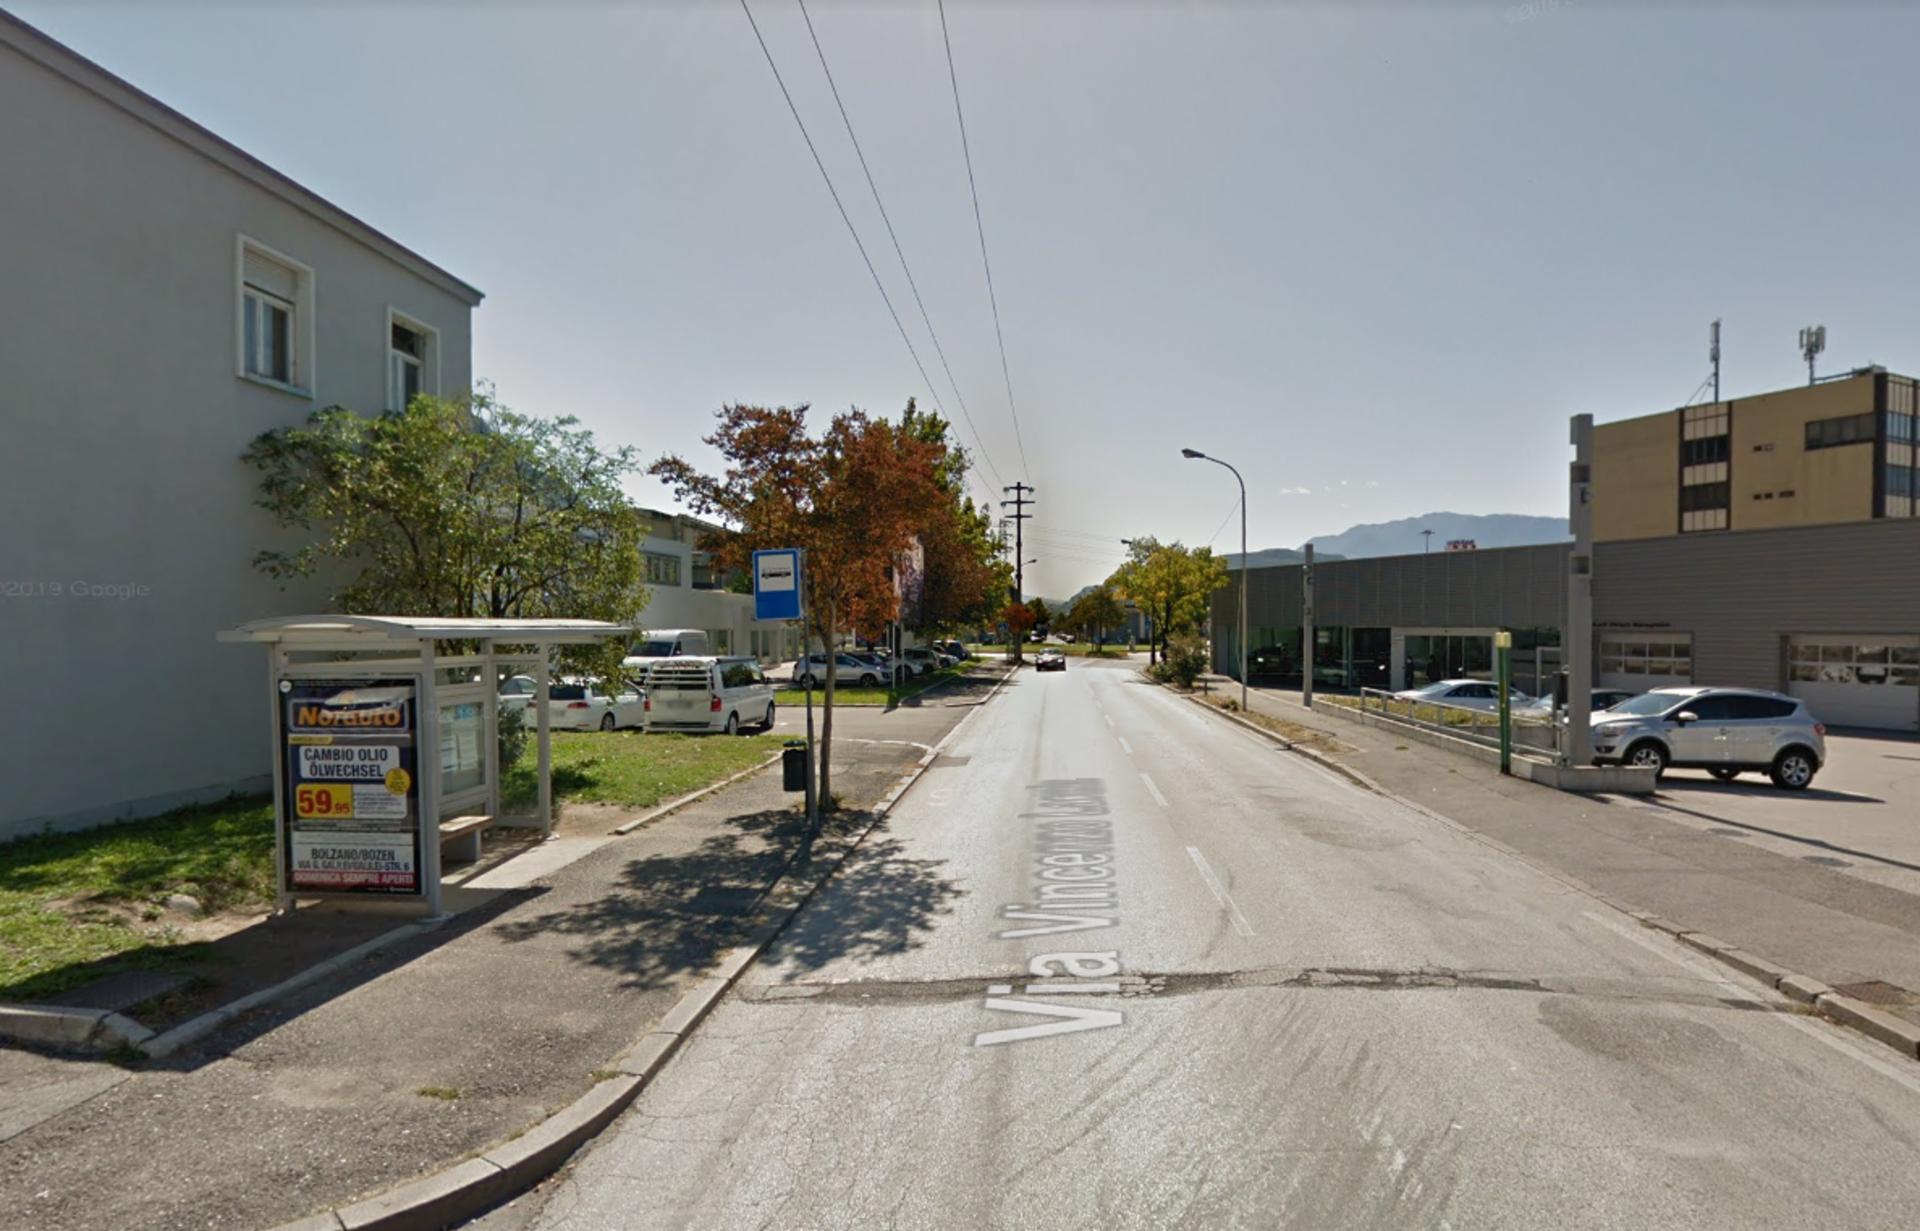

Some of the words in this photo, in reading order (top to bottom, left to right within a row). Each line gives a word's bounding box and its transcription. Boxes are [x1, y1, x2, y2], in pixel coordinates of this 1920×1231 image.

[304, 748, 355, 761] CAMBIO
[358, 748, 388, 761] OLIO
[309, 762, 384, 778] ÖLWECHSEL
[311, 848, 396, 861] BOLZANO/BOZEN
